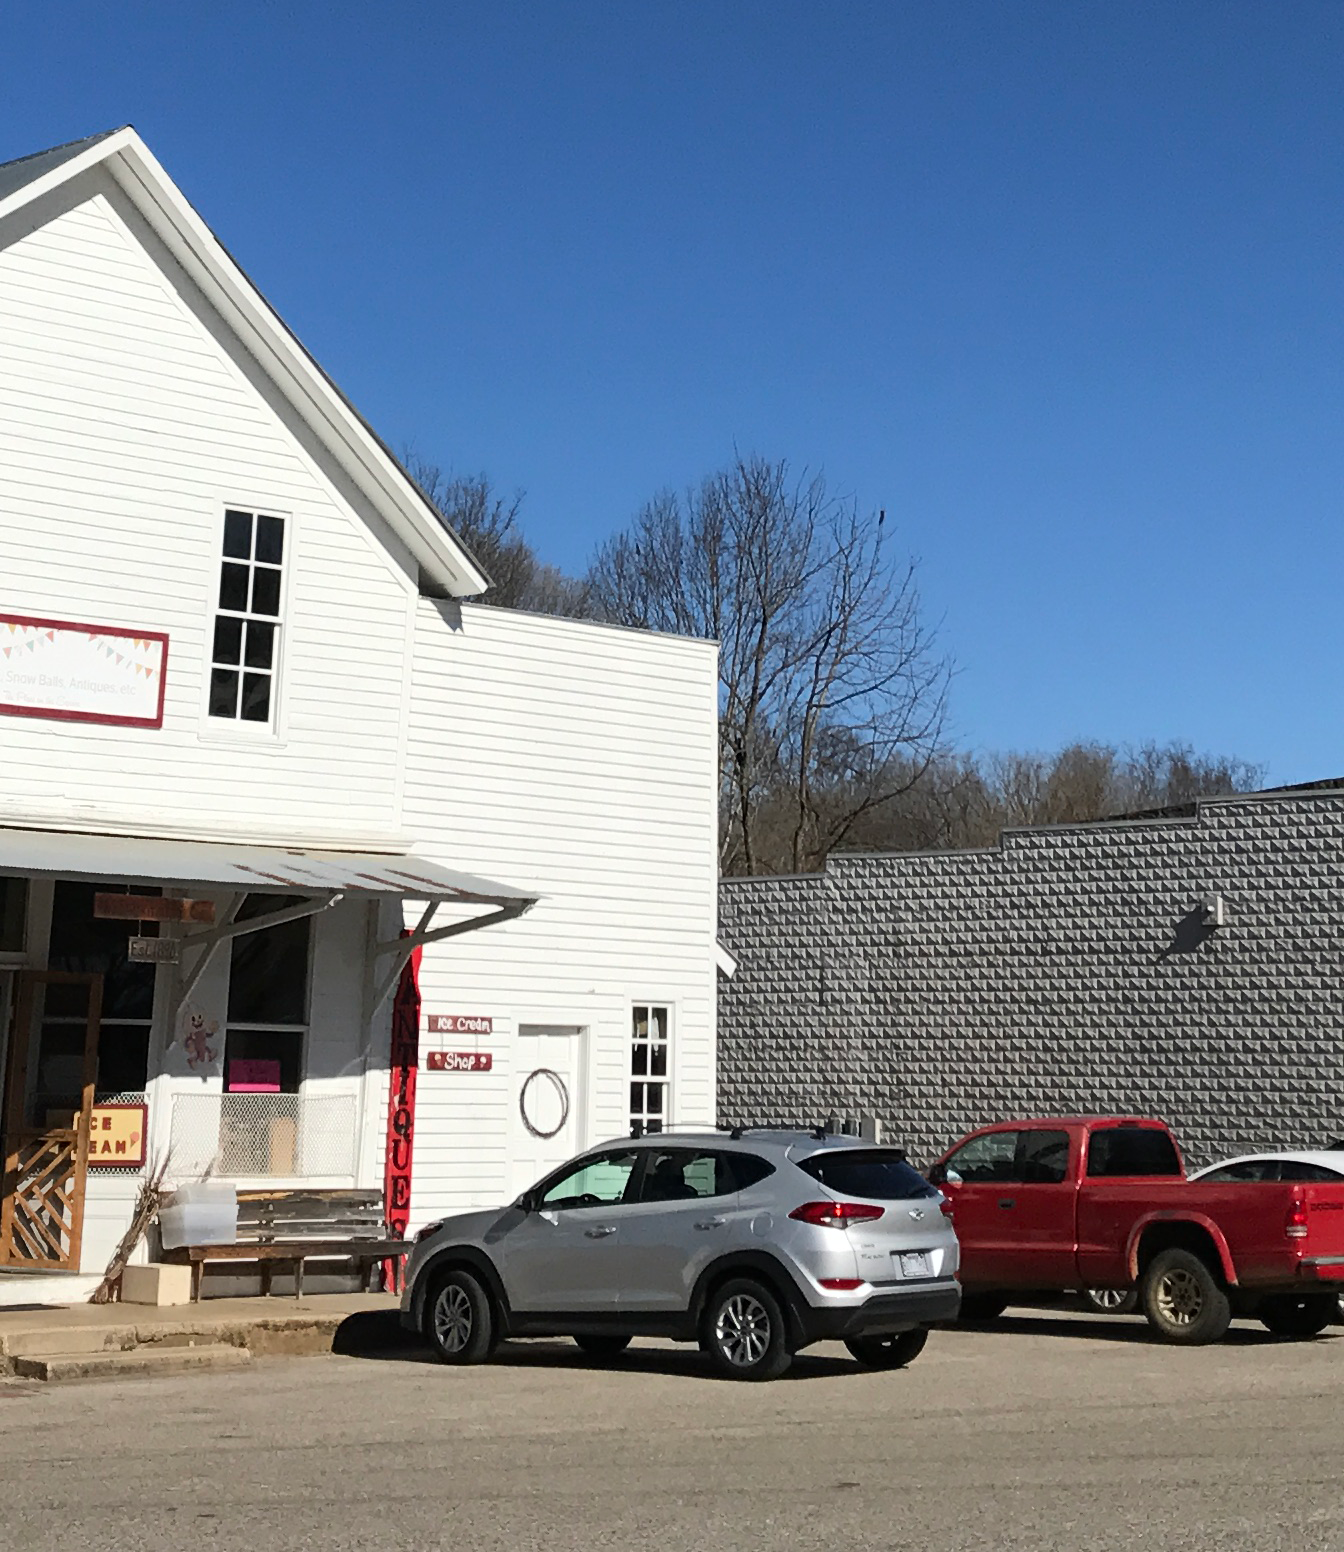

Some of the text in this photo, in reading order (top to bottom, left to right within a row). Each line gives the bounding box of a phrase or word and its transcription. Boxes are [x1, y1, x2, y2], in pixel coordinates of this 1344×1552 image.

[5, 670, 36, 685] Snow
[438, 1017, 491, 1032] Ice Cream
[444, 1052, 475, 1070] Shop
[391, 976, 420, 1240] ANTIQUES
[82, 1116, 112, 1131] CE
[86, 1140, 127, 1154] EAM
